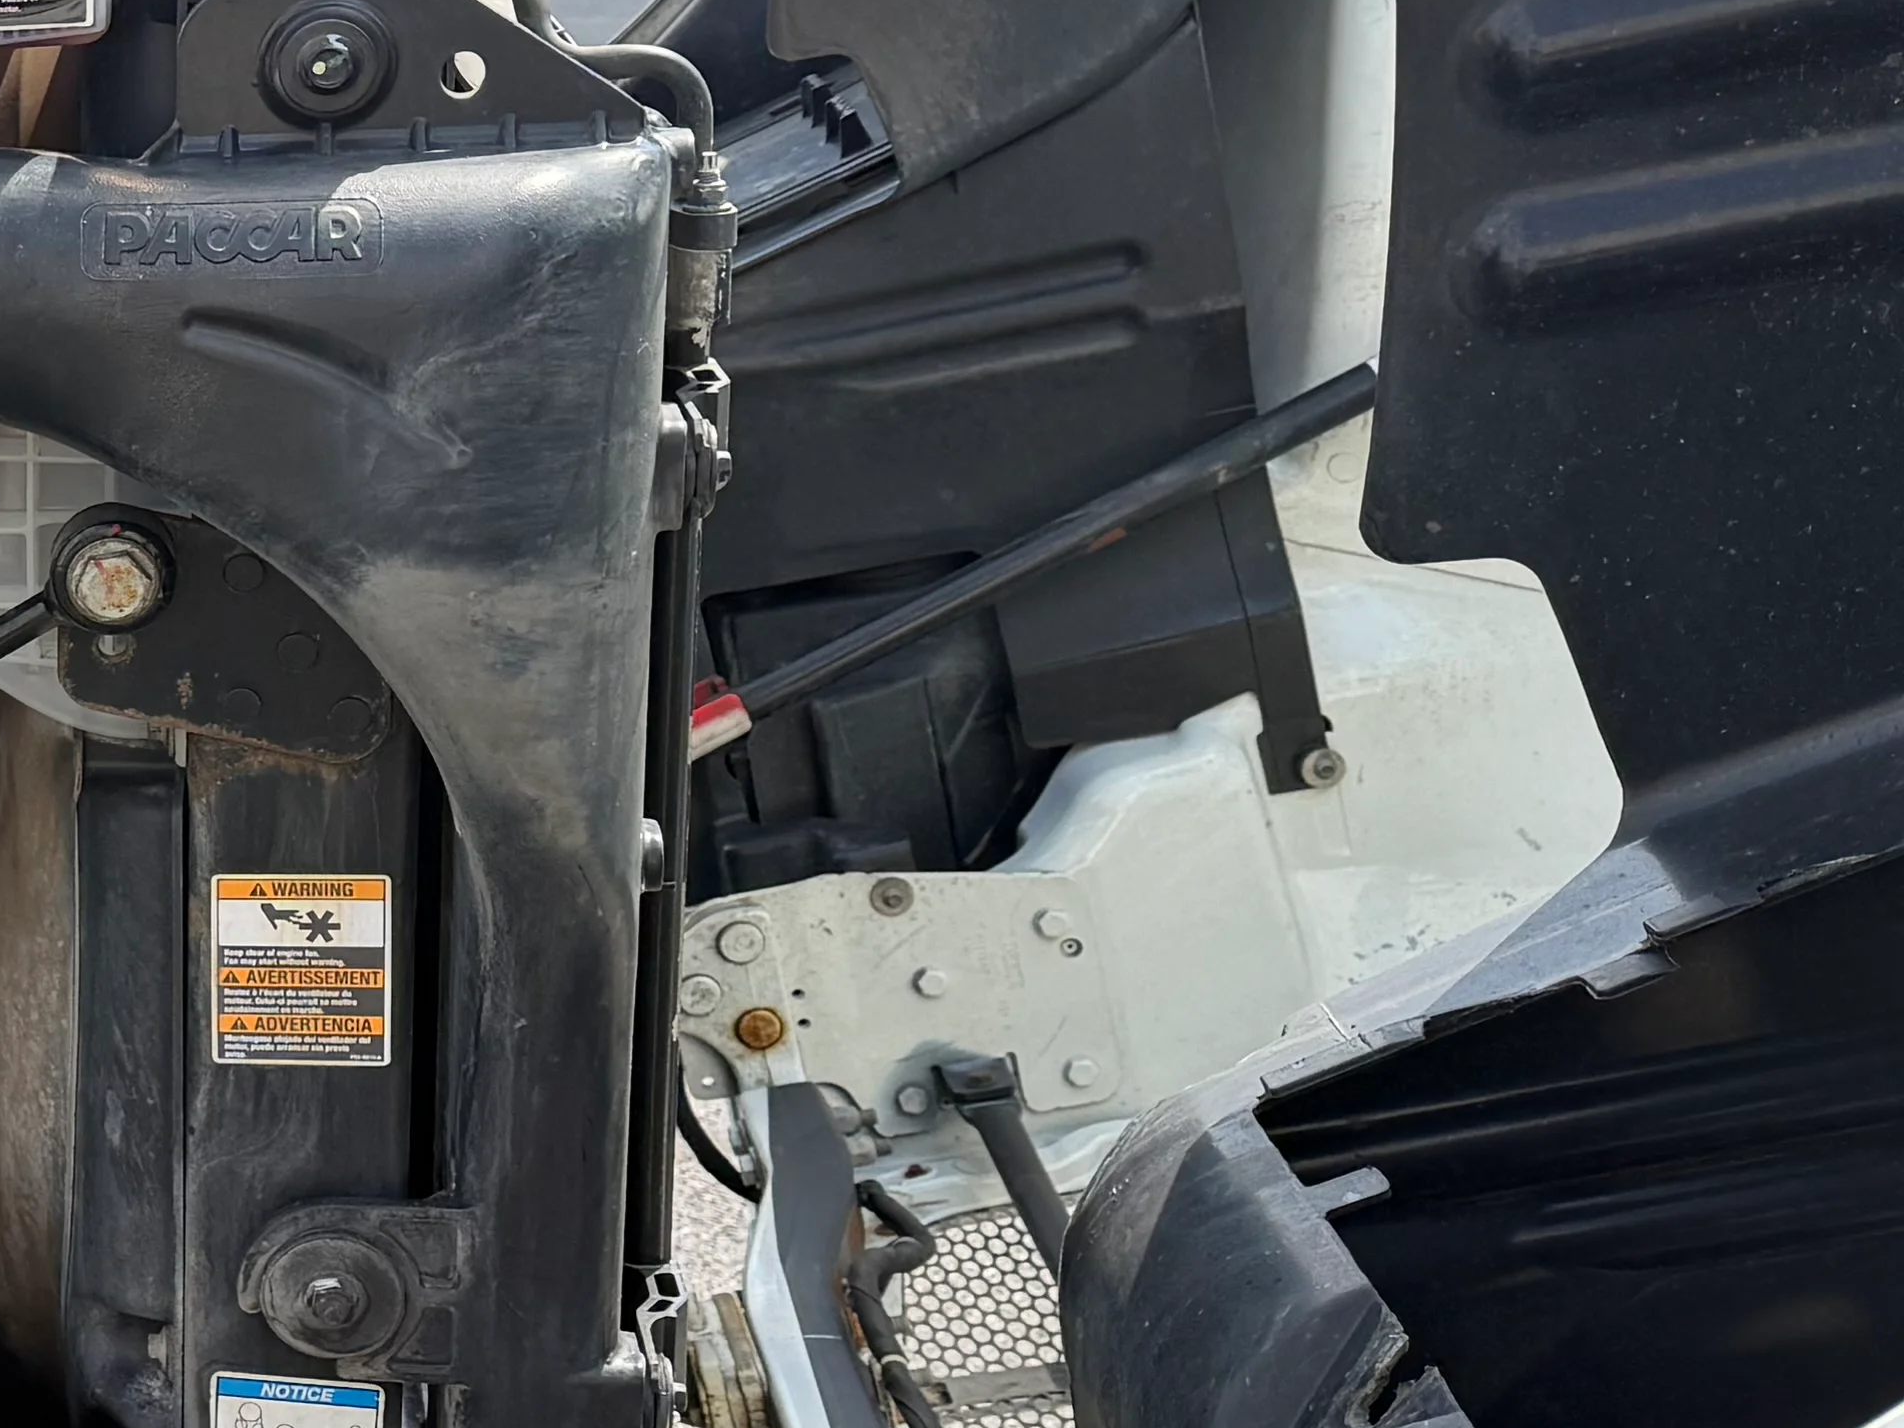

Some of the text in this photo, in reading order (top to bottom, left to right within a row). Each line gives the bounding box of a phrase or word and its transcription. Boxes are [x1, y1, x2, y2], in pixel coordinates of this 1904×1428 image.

[103, 203, 365, 265] PACCAR
[272, 882, 354, 897] WARNING
[224, 949, 243, 957] Keep
[246, 949, 265, 957] clear
[277, 950, 303, 958] engine
[279, 958, 309, 966] without
[312, 959, 346, 967] warning.
[247, 970, 380, 985] AVERTISSEMENT
[255, 1017, 372, 1032] ADVERTENCIA
[260, 1382, 335, 1403] NOTICE
